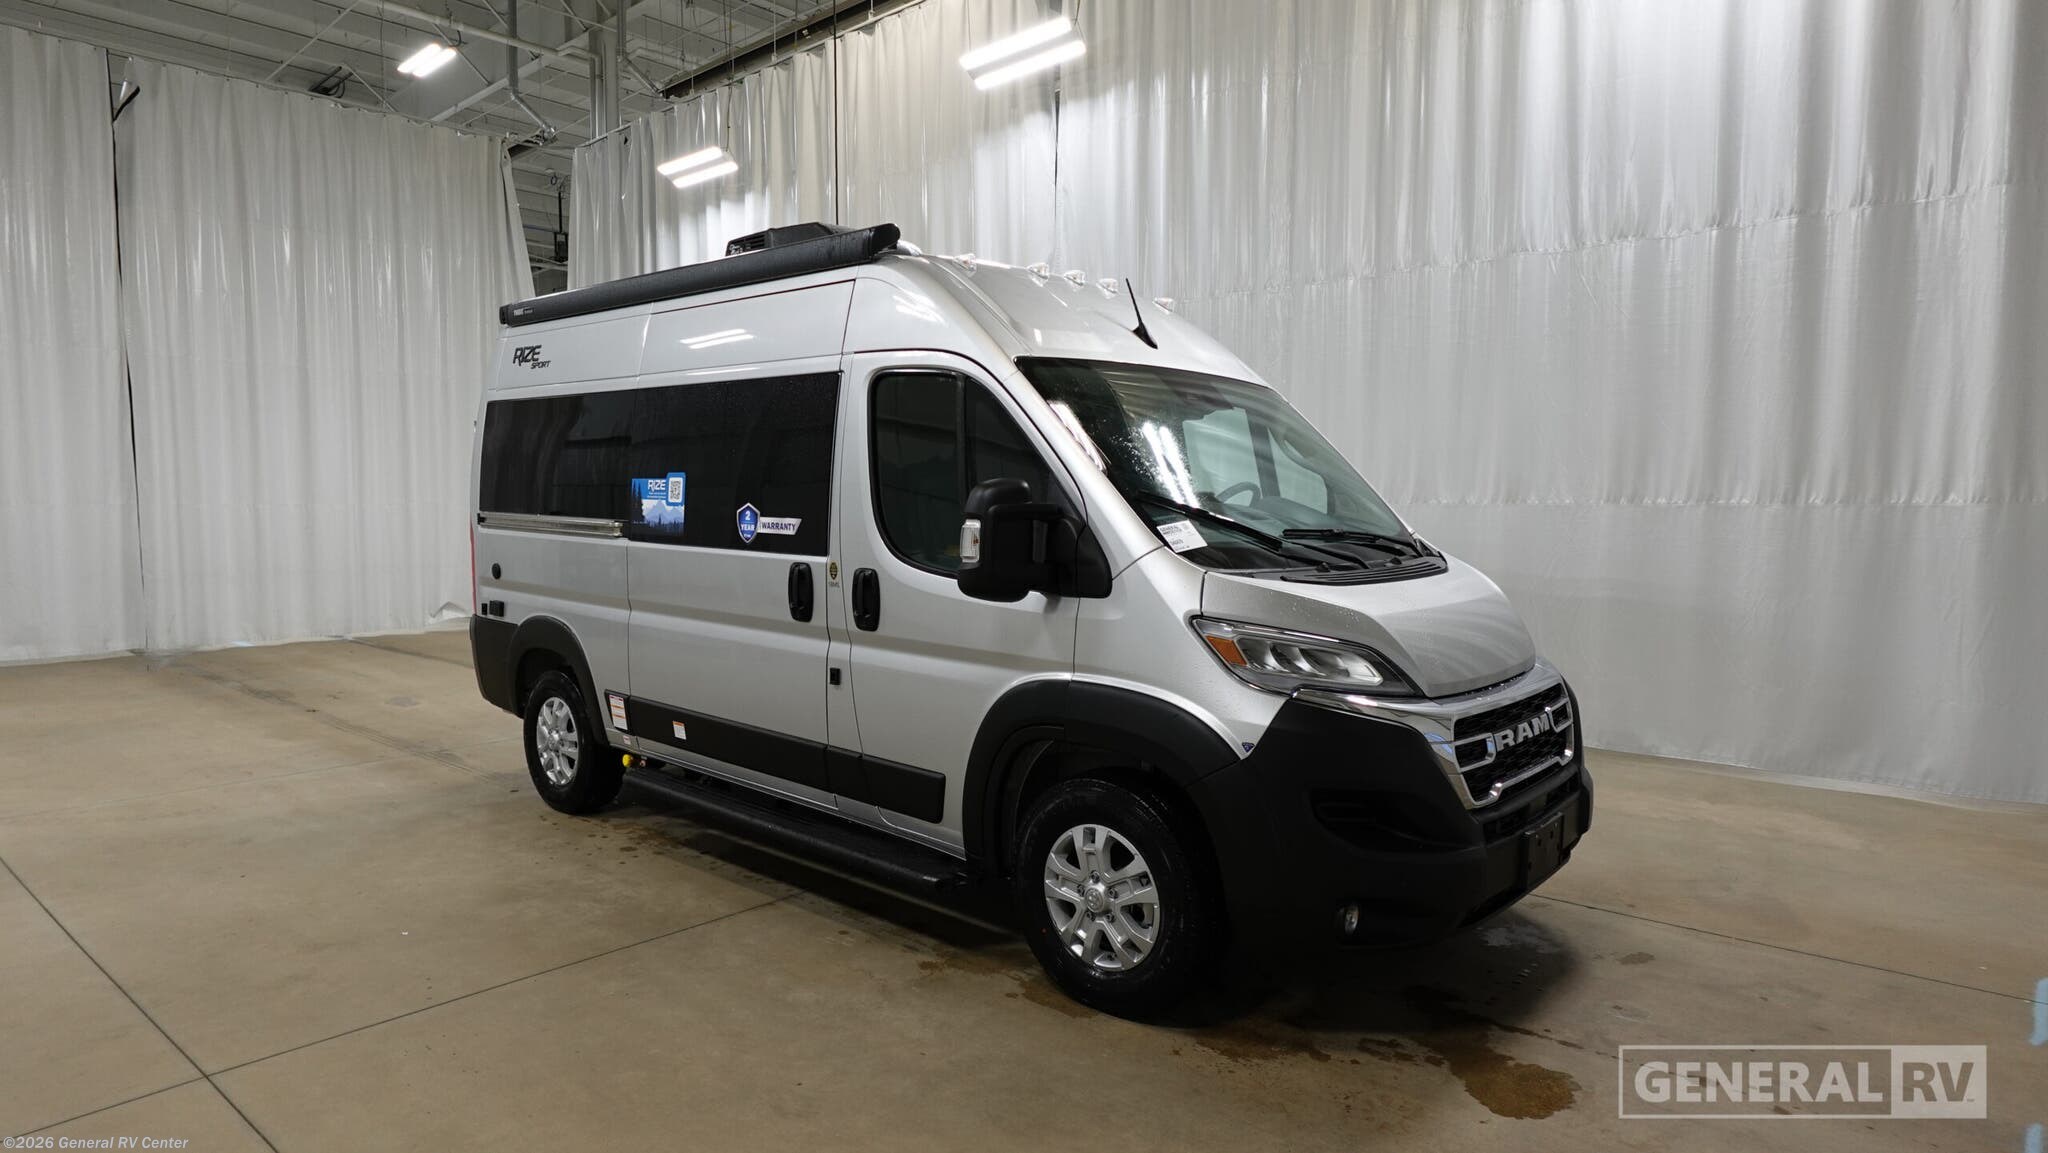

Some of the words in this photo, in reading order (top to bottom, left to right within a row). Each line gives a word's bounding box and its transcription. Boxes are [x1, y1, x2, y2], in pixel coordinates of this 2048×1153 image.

[513, 345, 542, 366] RIZE
[531, 360, 551, 369] SPORT
[647, 480, 666, 492] RIZE
[744, 510, 751, 521] 2
[740, 523, 755, 531] YEAR
[761, 521, 796, 532] WARRANTY
[1494, 714, 1550, 751] RAM
